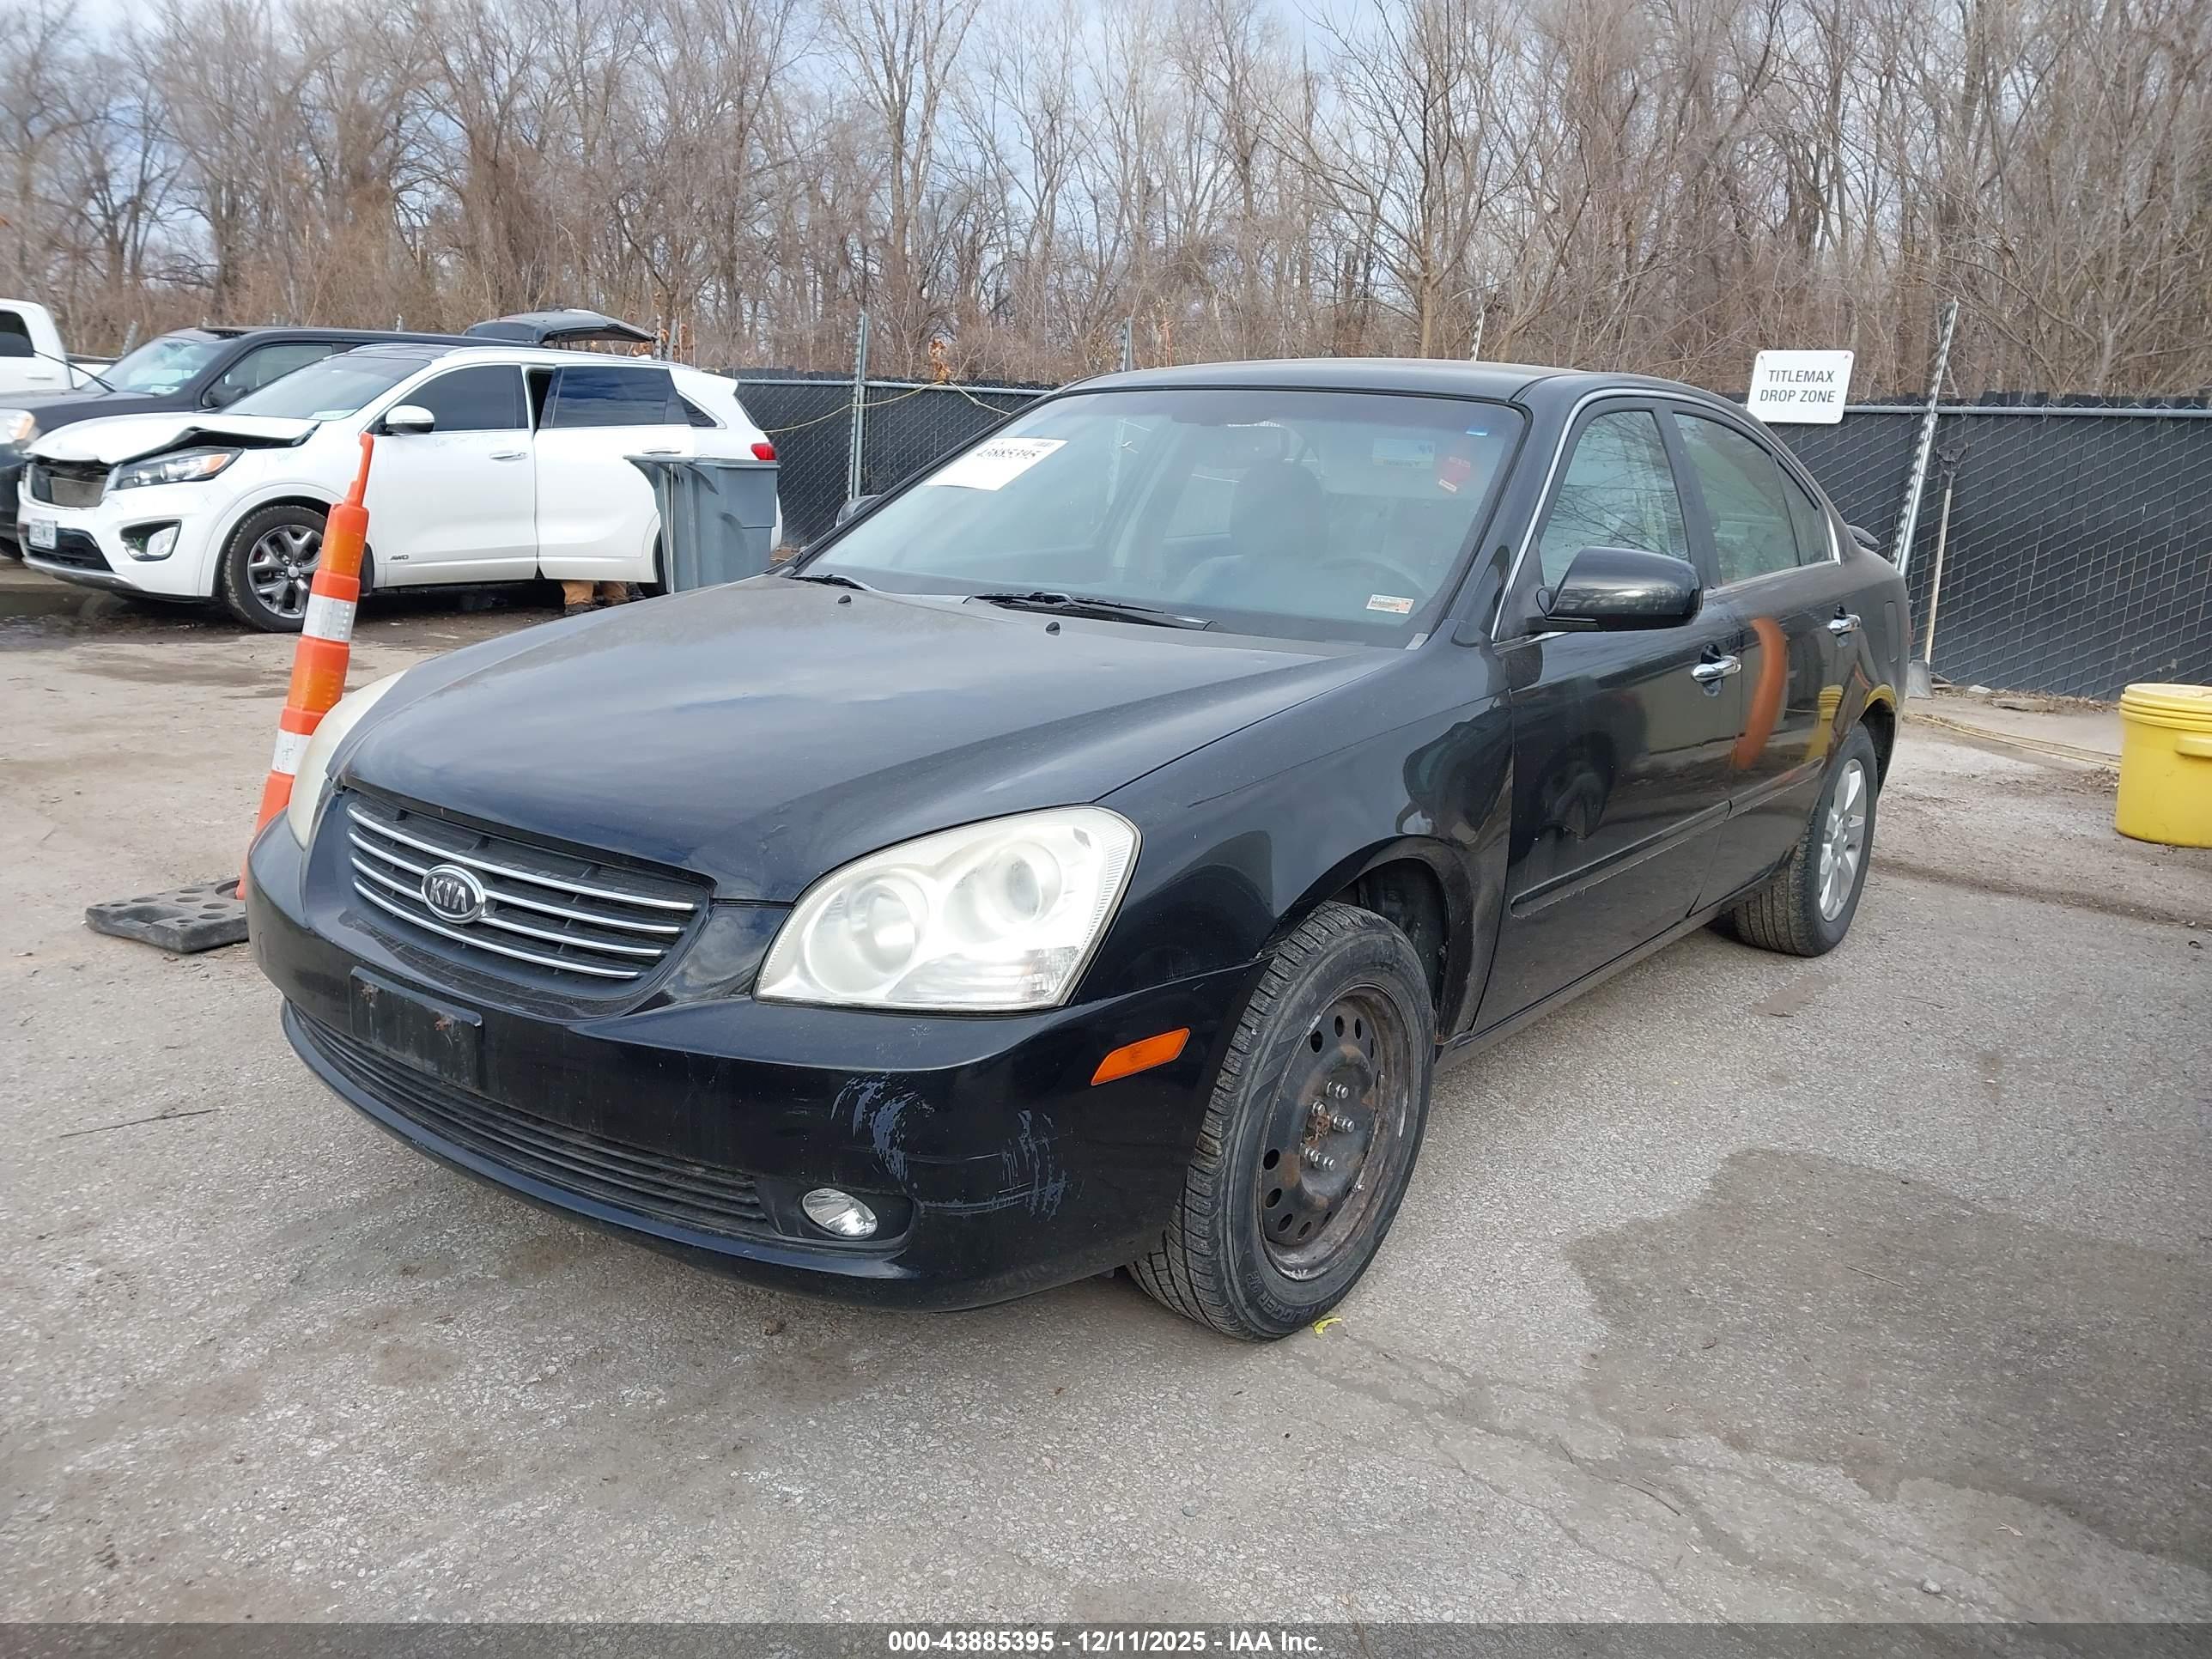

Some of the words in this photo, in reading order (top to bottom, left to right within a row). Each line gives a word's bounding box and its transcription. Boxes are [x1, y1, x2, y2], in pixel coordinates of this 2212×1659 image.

[1768, 369, 1835, 383] TITLEMAX
[1759, 389, 1796, 402] DROP
[1800, 390, 1836, 403] ZONE
[428, 876, 468, 913] KIA
